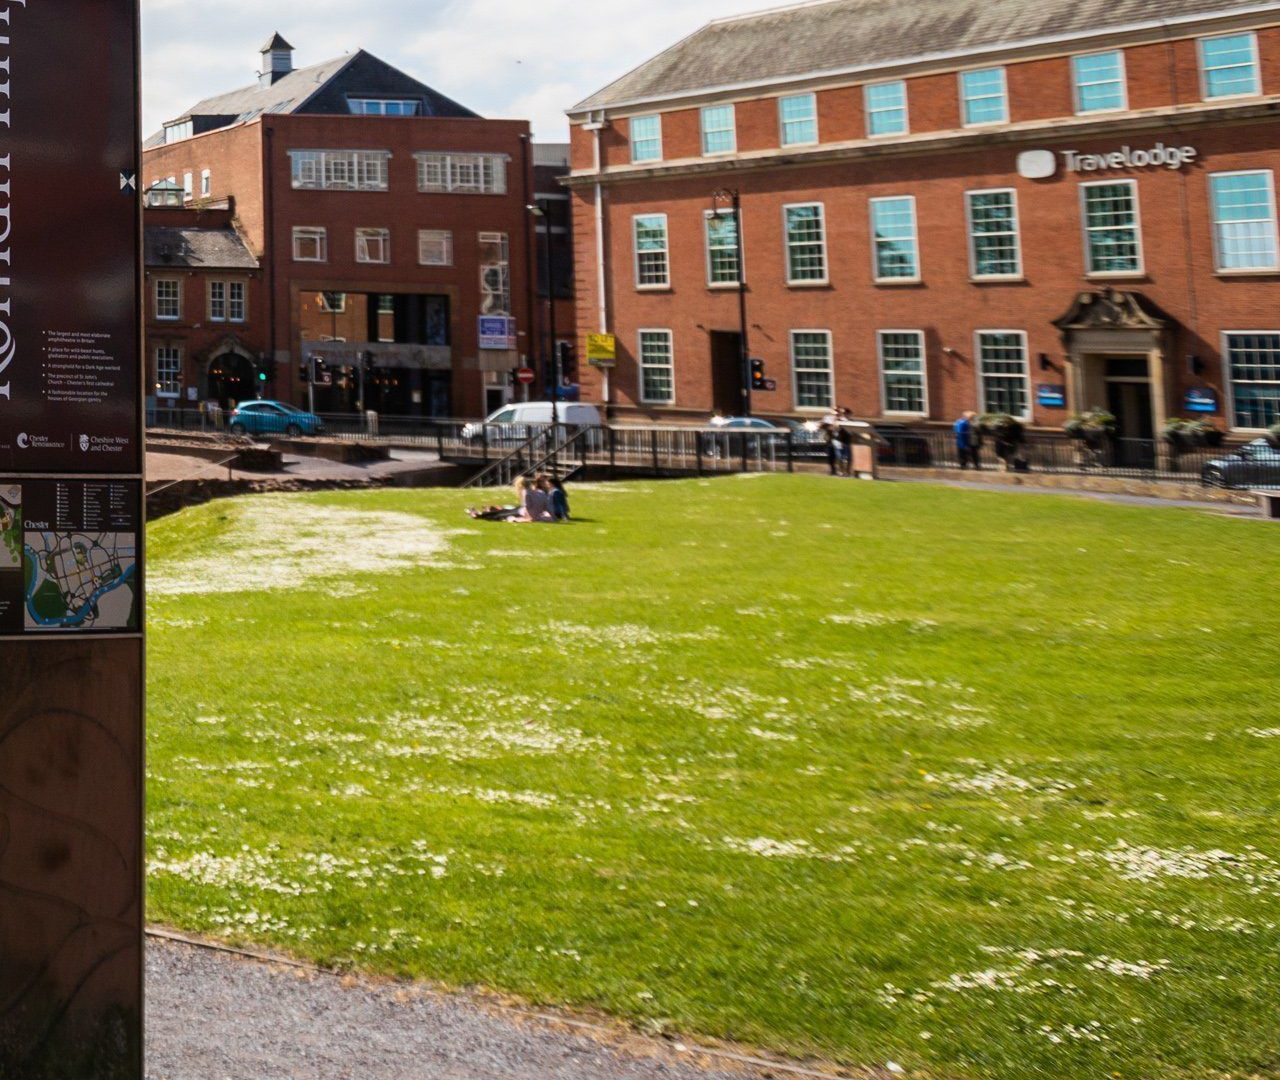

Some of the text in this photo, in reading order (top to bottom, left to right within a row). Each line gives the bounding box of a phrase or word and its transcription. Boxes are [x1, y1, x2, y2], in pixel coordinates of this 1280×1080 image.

[1059, 142, 1197, 171] Travelodge
[90, 436, 129, 444] Cheshire West
[91, 444, 123, 452] and Chester
[24, 520, 49, 529] Chester
